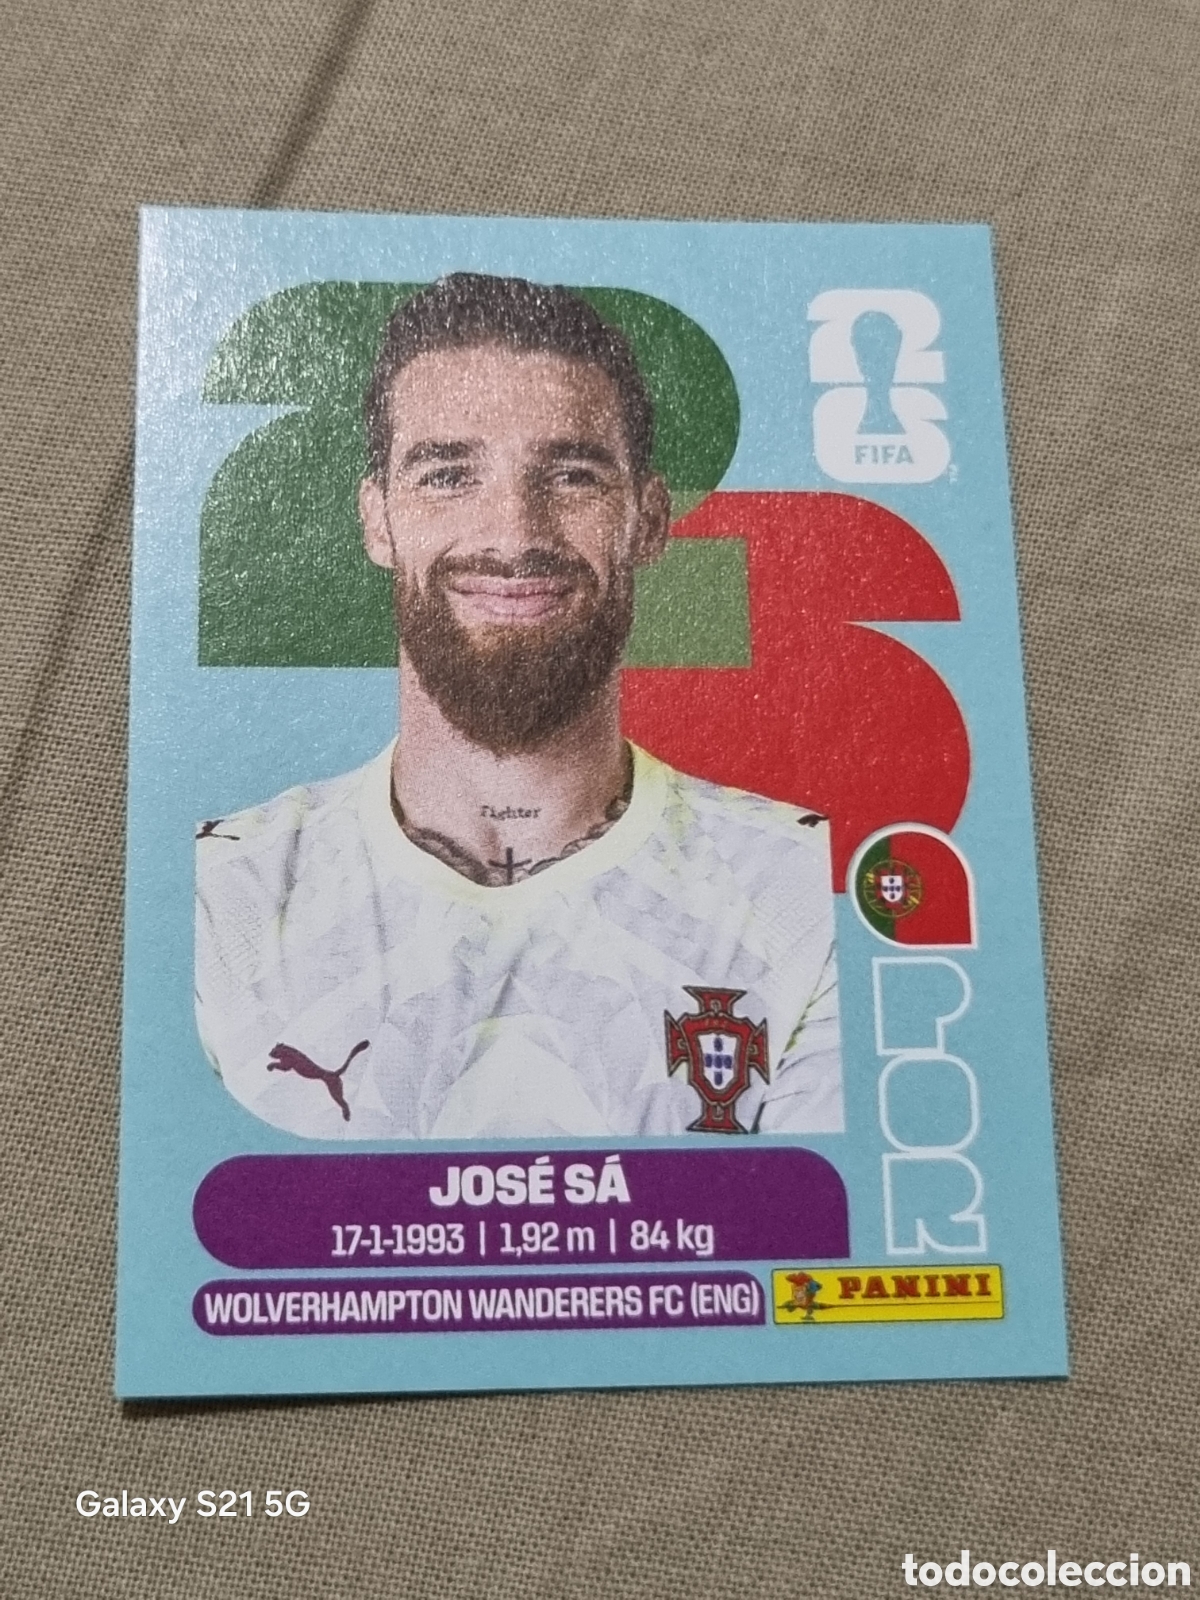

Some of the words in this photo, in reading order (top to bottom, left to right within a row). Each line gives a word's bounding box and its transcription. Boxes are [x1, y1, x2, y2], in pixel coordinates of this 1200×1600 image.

[854, 444, 914, 465] FIFA
[480, 804, 543, 821] Fighter
[428, 1155, 555, 1207] JOSÉ
[563, 1153, 631, 1205] SÁ
[331, 1222, 465, 1256] 17-1-1993
[500, 1221, 559, 1257] 1,92
[567, 1225, 595, 1252] m
[629, 1219, 669, 1251] 84
[676, 1217, 714, 1256] kg
[204, 1288, 463, 1325] WOLVERHAMPTON
[468, 1285, 642, 1320] WANDERERS
[648, 1283, 684, 1317] FC
[690, 1280, 760, 1318] (ENG)
[837, 1273, 992, 1300] PANINI
